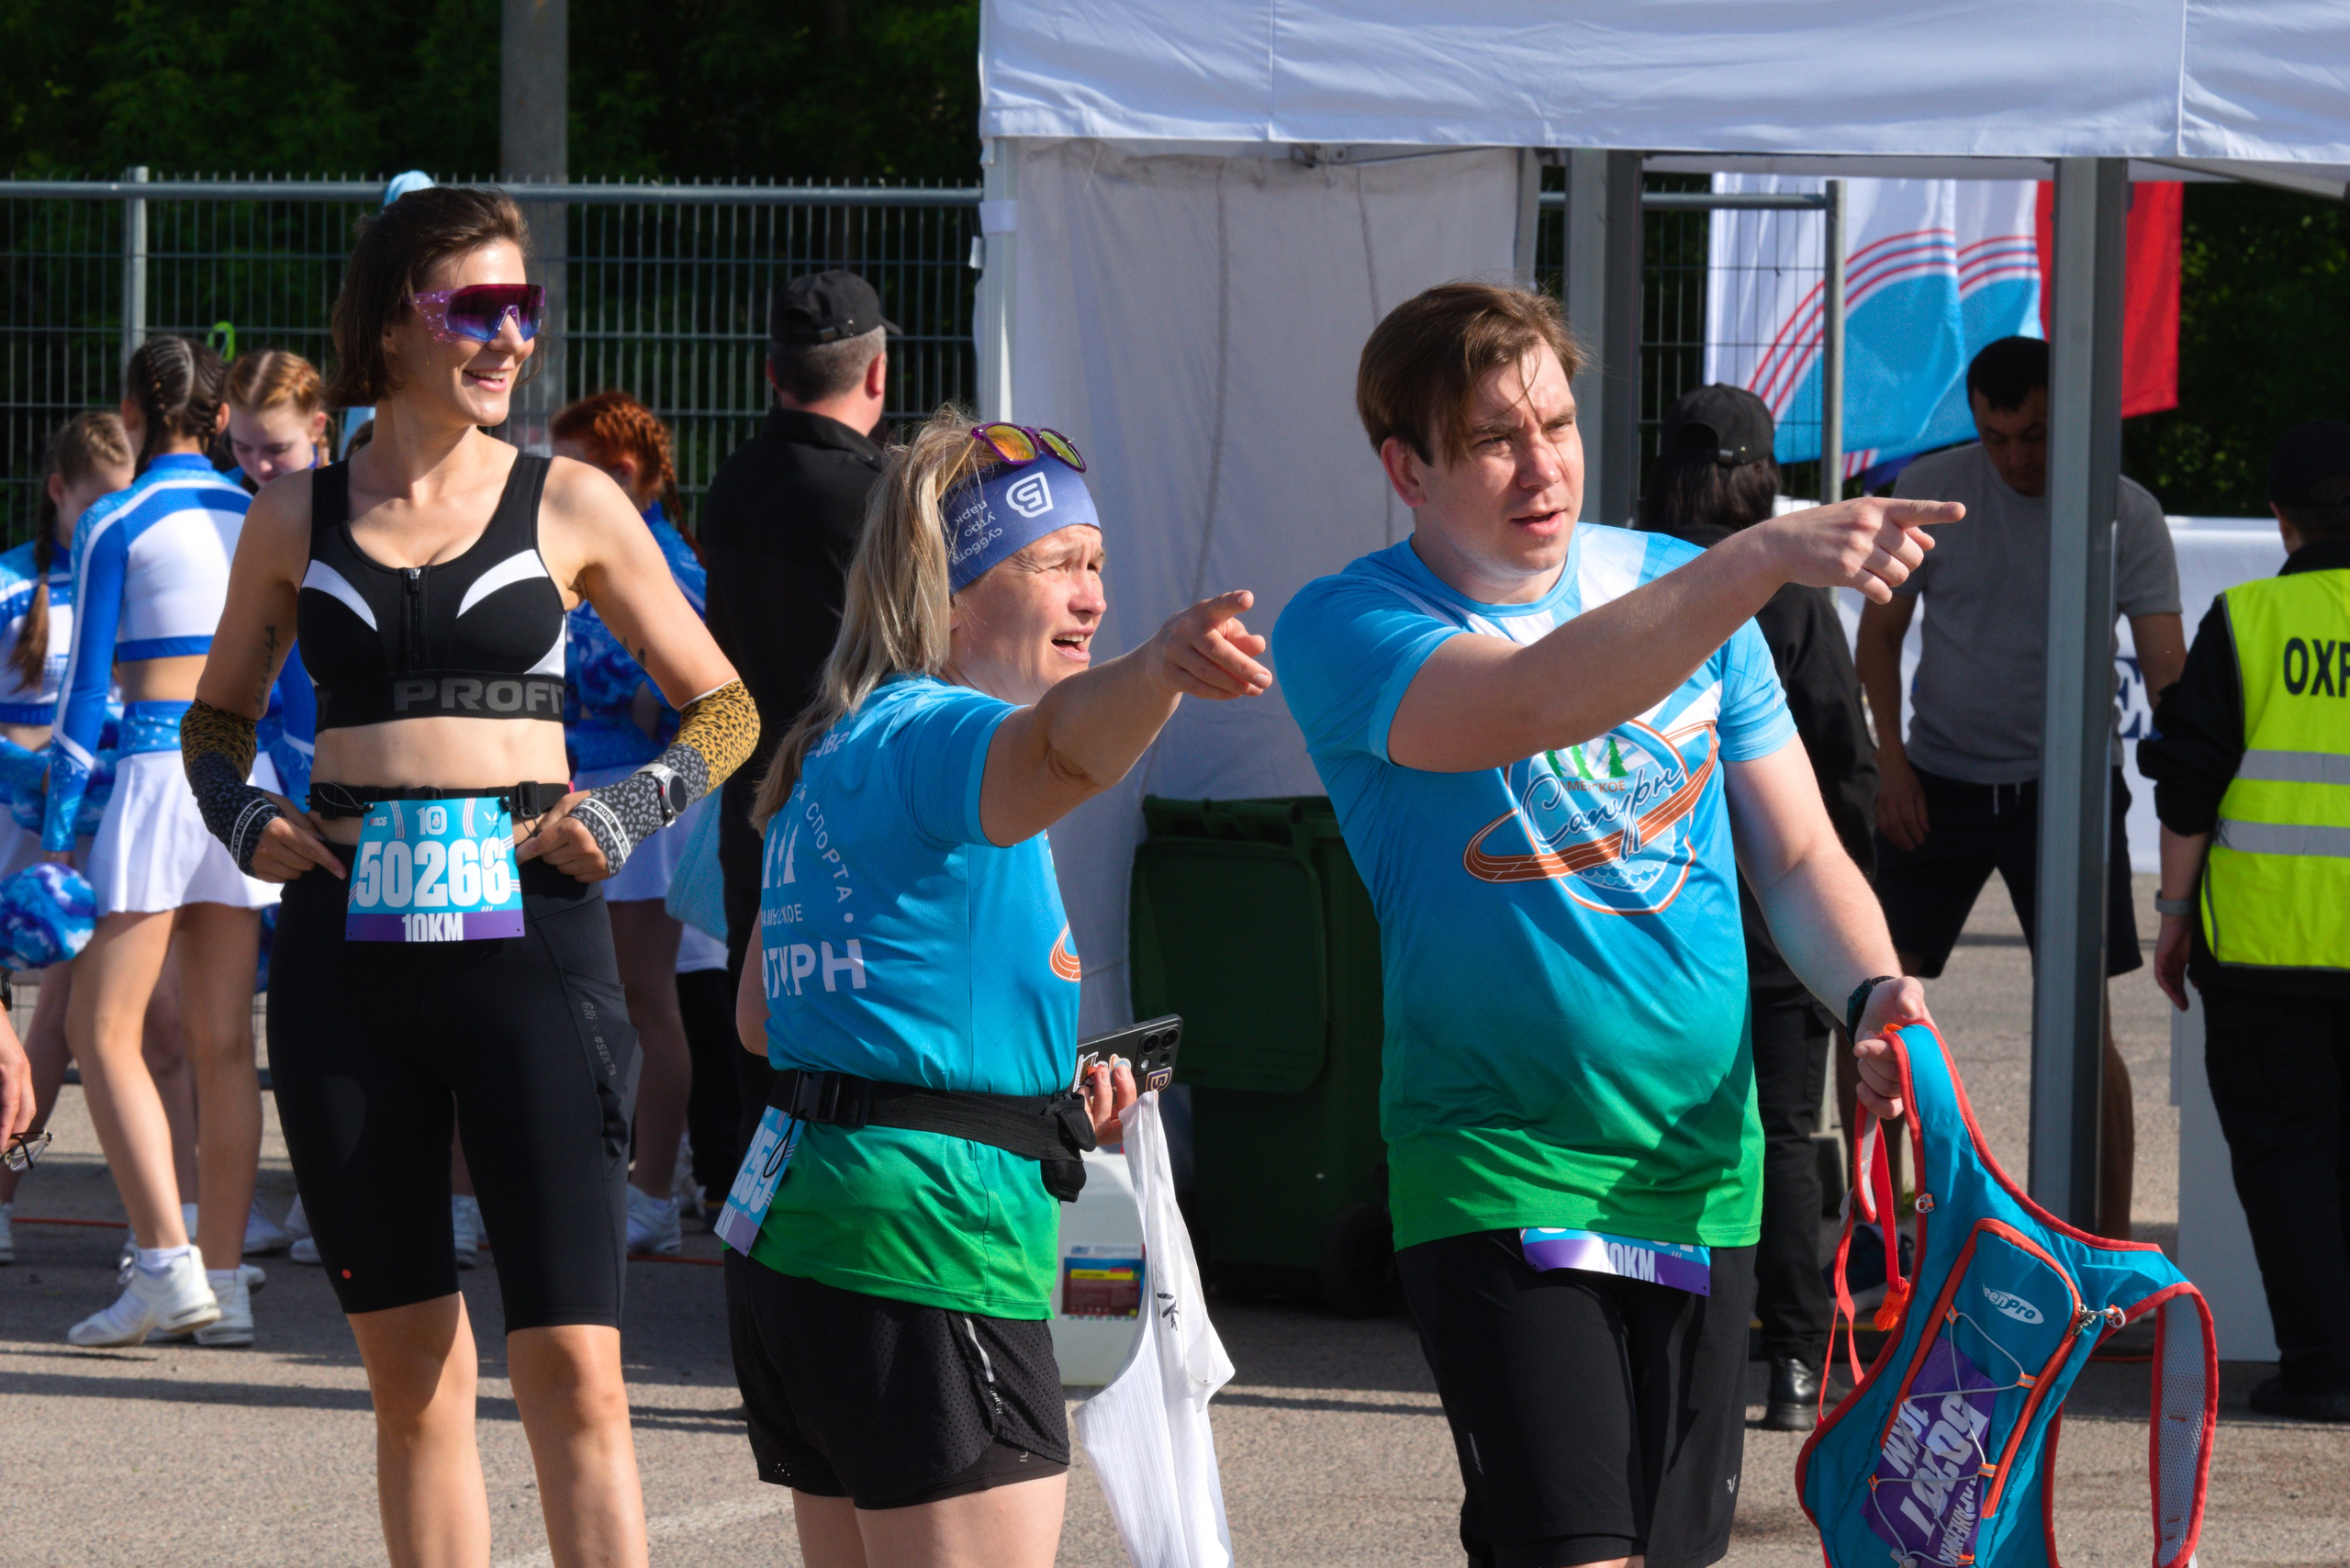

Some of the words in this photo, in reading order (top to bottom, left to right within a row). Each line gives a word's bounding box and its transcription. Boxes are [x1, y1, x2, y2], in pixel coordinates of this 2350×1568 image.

[955, 500, 988, 525] парк
[964, 510, 996, 537] утро
[951, 527, 1003, 566] суббота
[238, 806, 256, 831] TRUST
[593, 803, 615, 824] TRUST
[615, 831, 623, 842] IN
[805, 801, 853, 903] СПОРТА
[356, 837, 511, 908] 50266
[1982, 1286, 2036, 1320] eenPro
